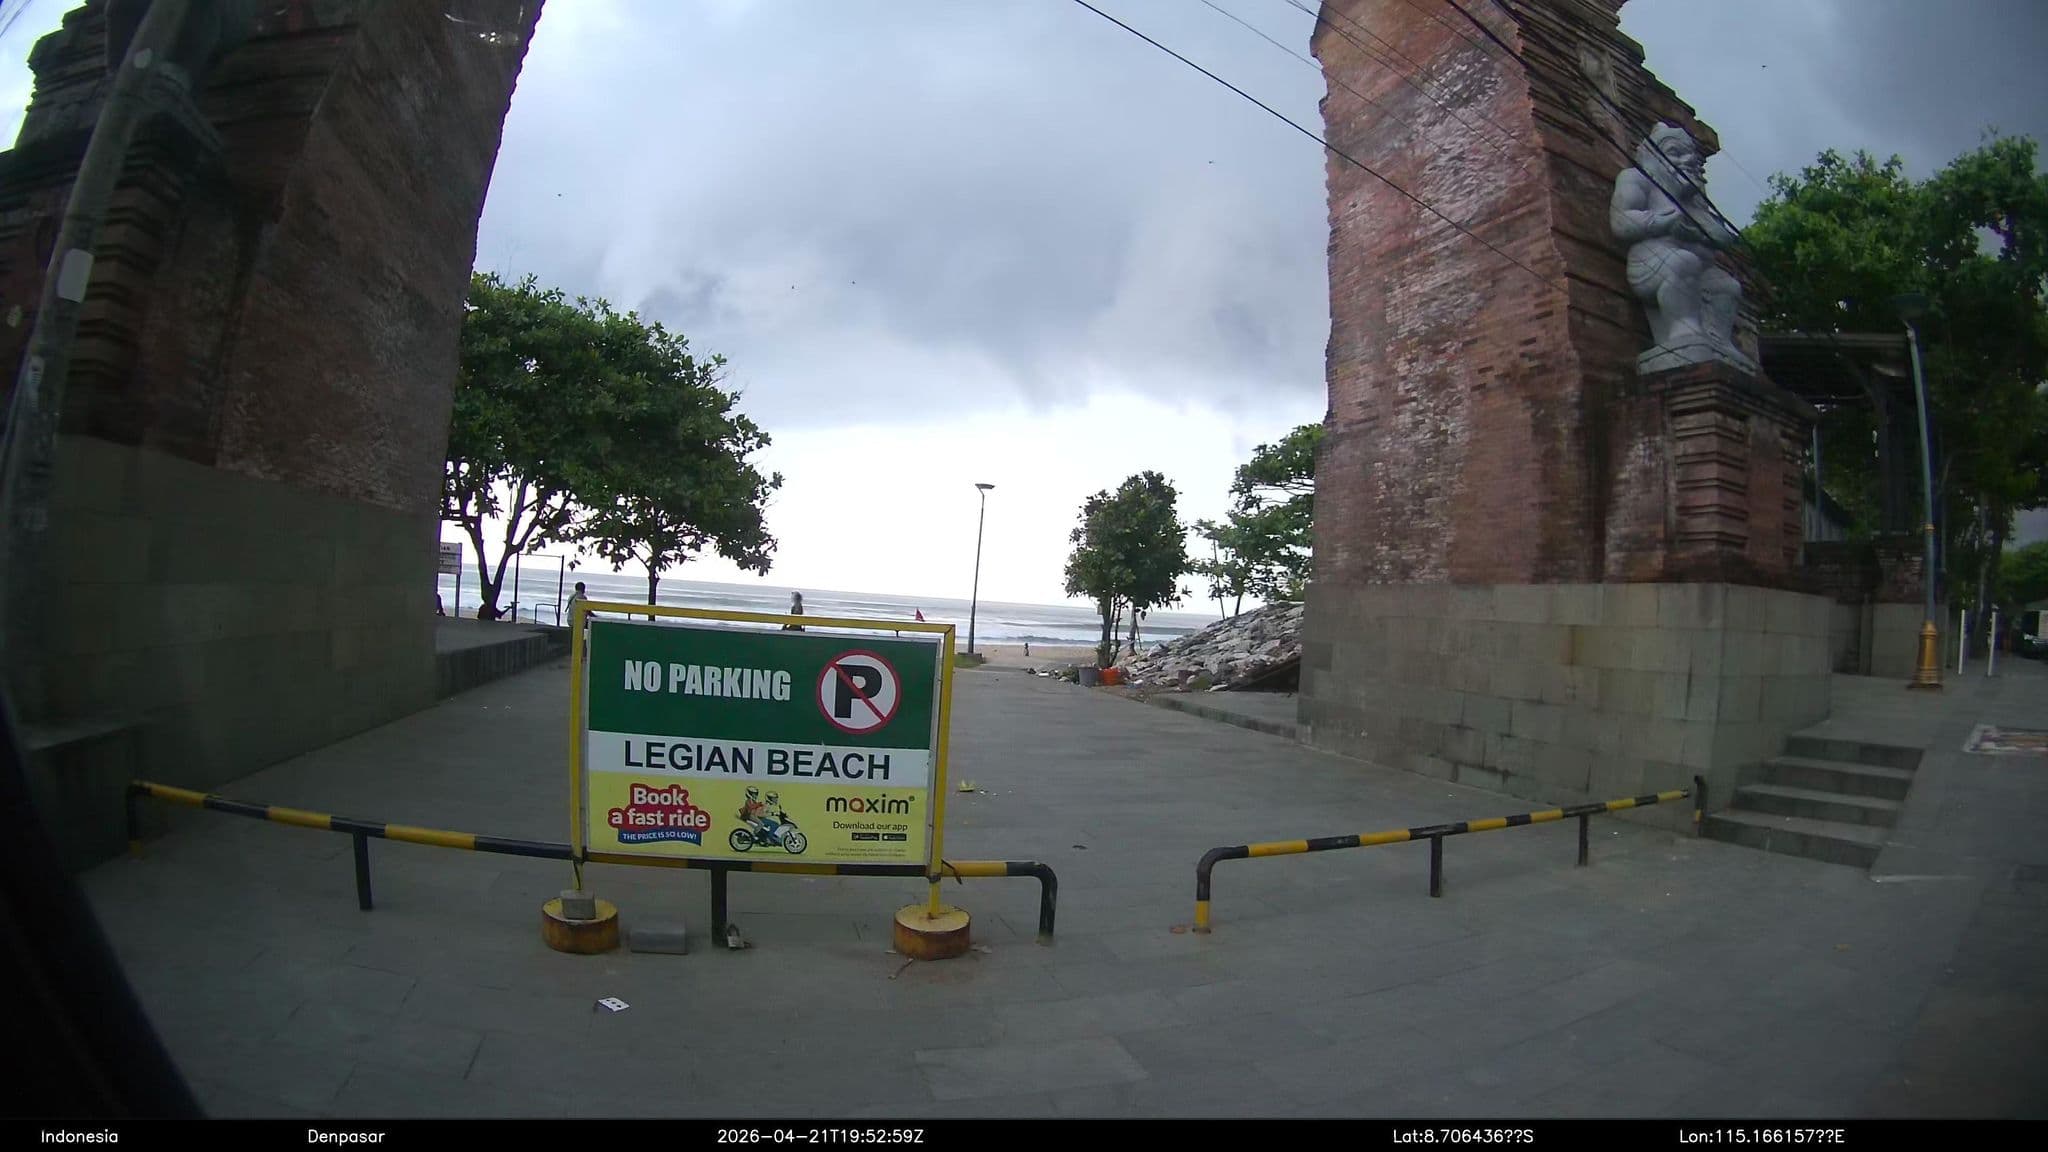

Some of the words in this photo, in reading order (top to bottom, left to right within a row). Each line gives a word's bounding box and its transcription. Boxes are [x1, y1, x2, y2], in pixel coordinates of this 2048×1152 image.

[624, 660, 662, 693] NO
[669, 663, 791, 701] PARKING
[834, 664, 882, 719] P
[624, 740, 754, 776] LEGIAN
[767, 749, 891, 780] BEACH
[633, 787, 685, 806] Book
[826, 794, 909, 814] maxim
[611, 811, 623, 825] a
[627, 808, 664, 826] fast
[669, 808, 707, 827] ride
[832, 821, 875, 830] Download
[892, 823, 908, 832] app
[637, 832, 658, 840] PRICE
[676, 831, 697, 840] LOW!
